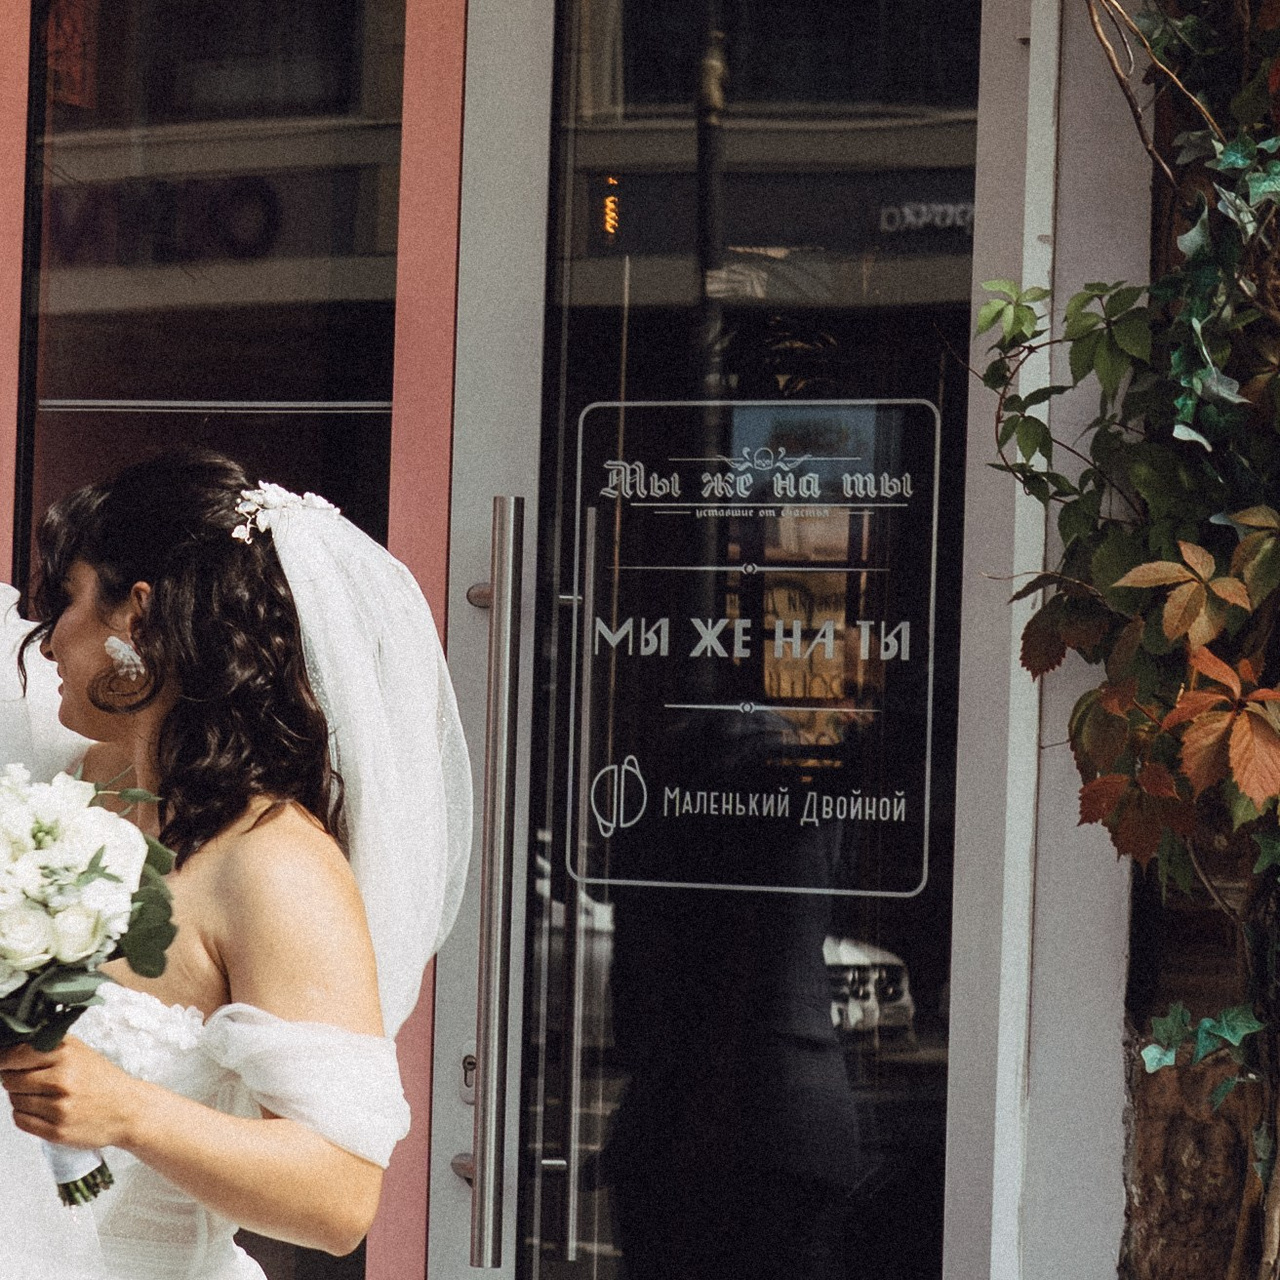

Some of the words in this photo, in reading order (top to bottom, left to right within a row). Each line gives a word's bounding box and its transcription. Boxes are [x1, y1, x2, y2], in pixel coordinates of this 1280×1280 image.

[599, 460, 682, 499] Мы
[701, 471, 754, 499] же
[773, 471, 822, 498] на
[842, 471, 914, 498] ты
[593, 617, 669, 658] МЫ
[689, 617, 752, 659] ЖЕ
[773, 619, 835, 660] НА
[855, 619, 911, 661] ТЫ
